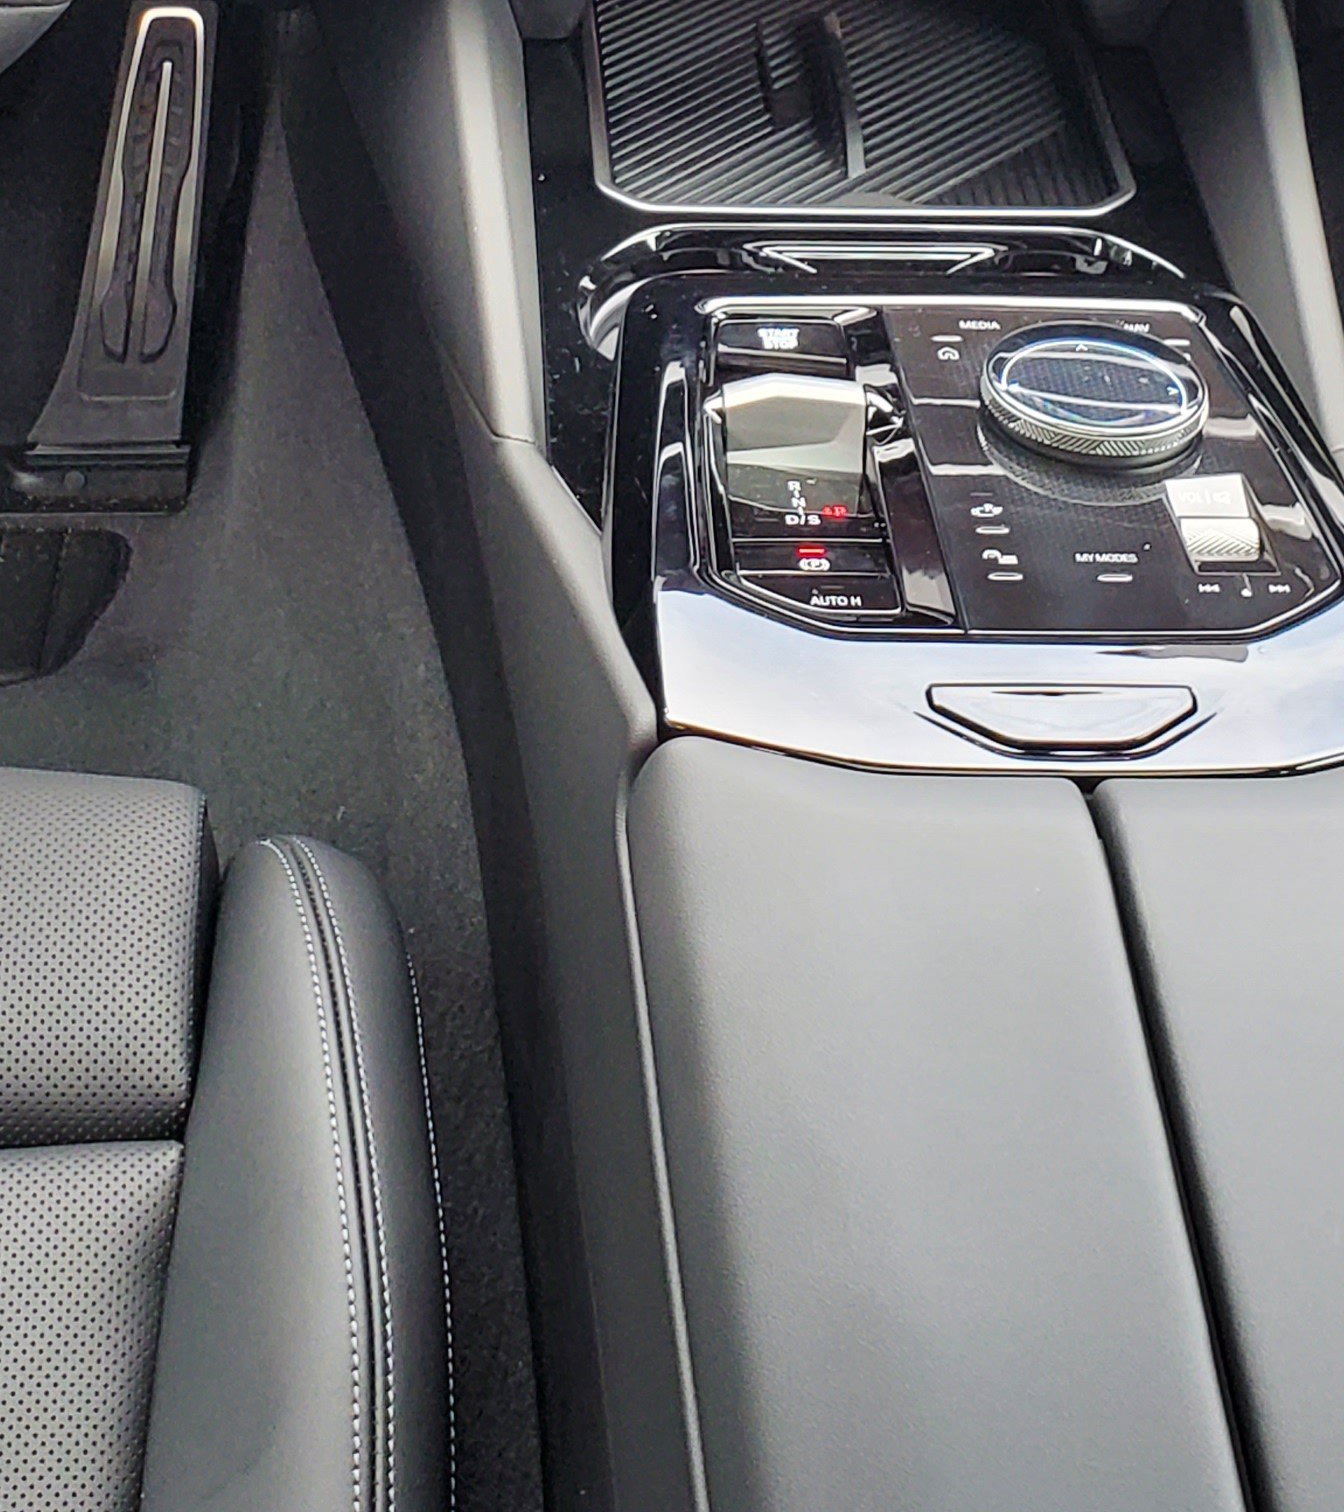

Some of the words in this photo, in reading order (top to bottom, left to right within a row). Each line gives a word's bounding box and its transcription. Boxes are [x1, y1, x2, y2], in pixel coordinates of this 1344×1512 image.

[958, 319, 1001, 331] MEDIA
[791, 497, 806, 508] N
[1075, 552, 1095, 564] MY
[1095, 553, 1139, 564] MODES
[810, 595, 848, 607] AUTO
[850, 595, 862, 607] H
